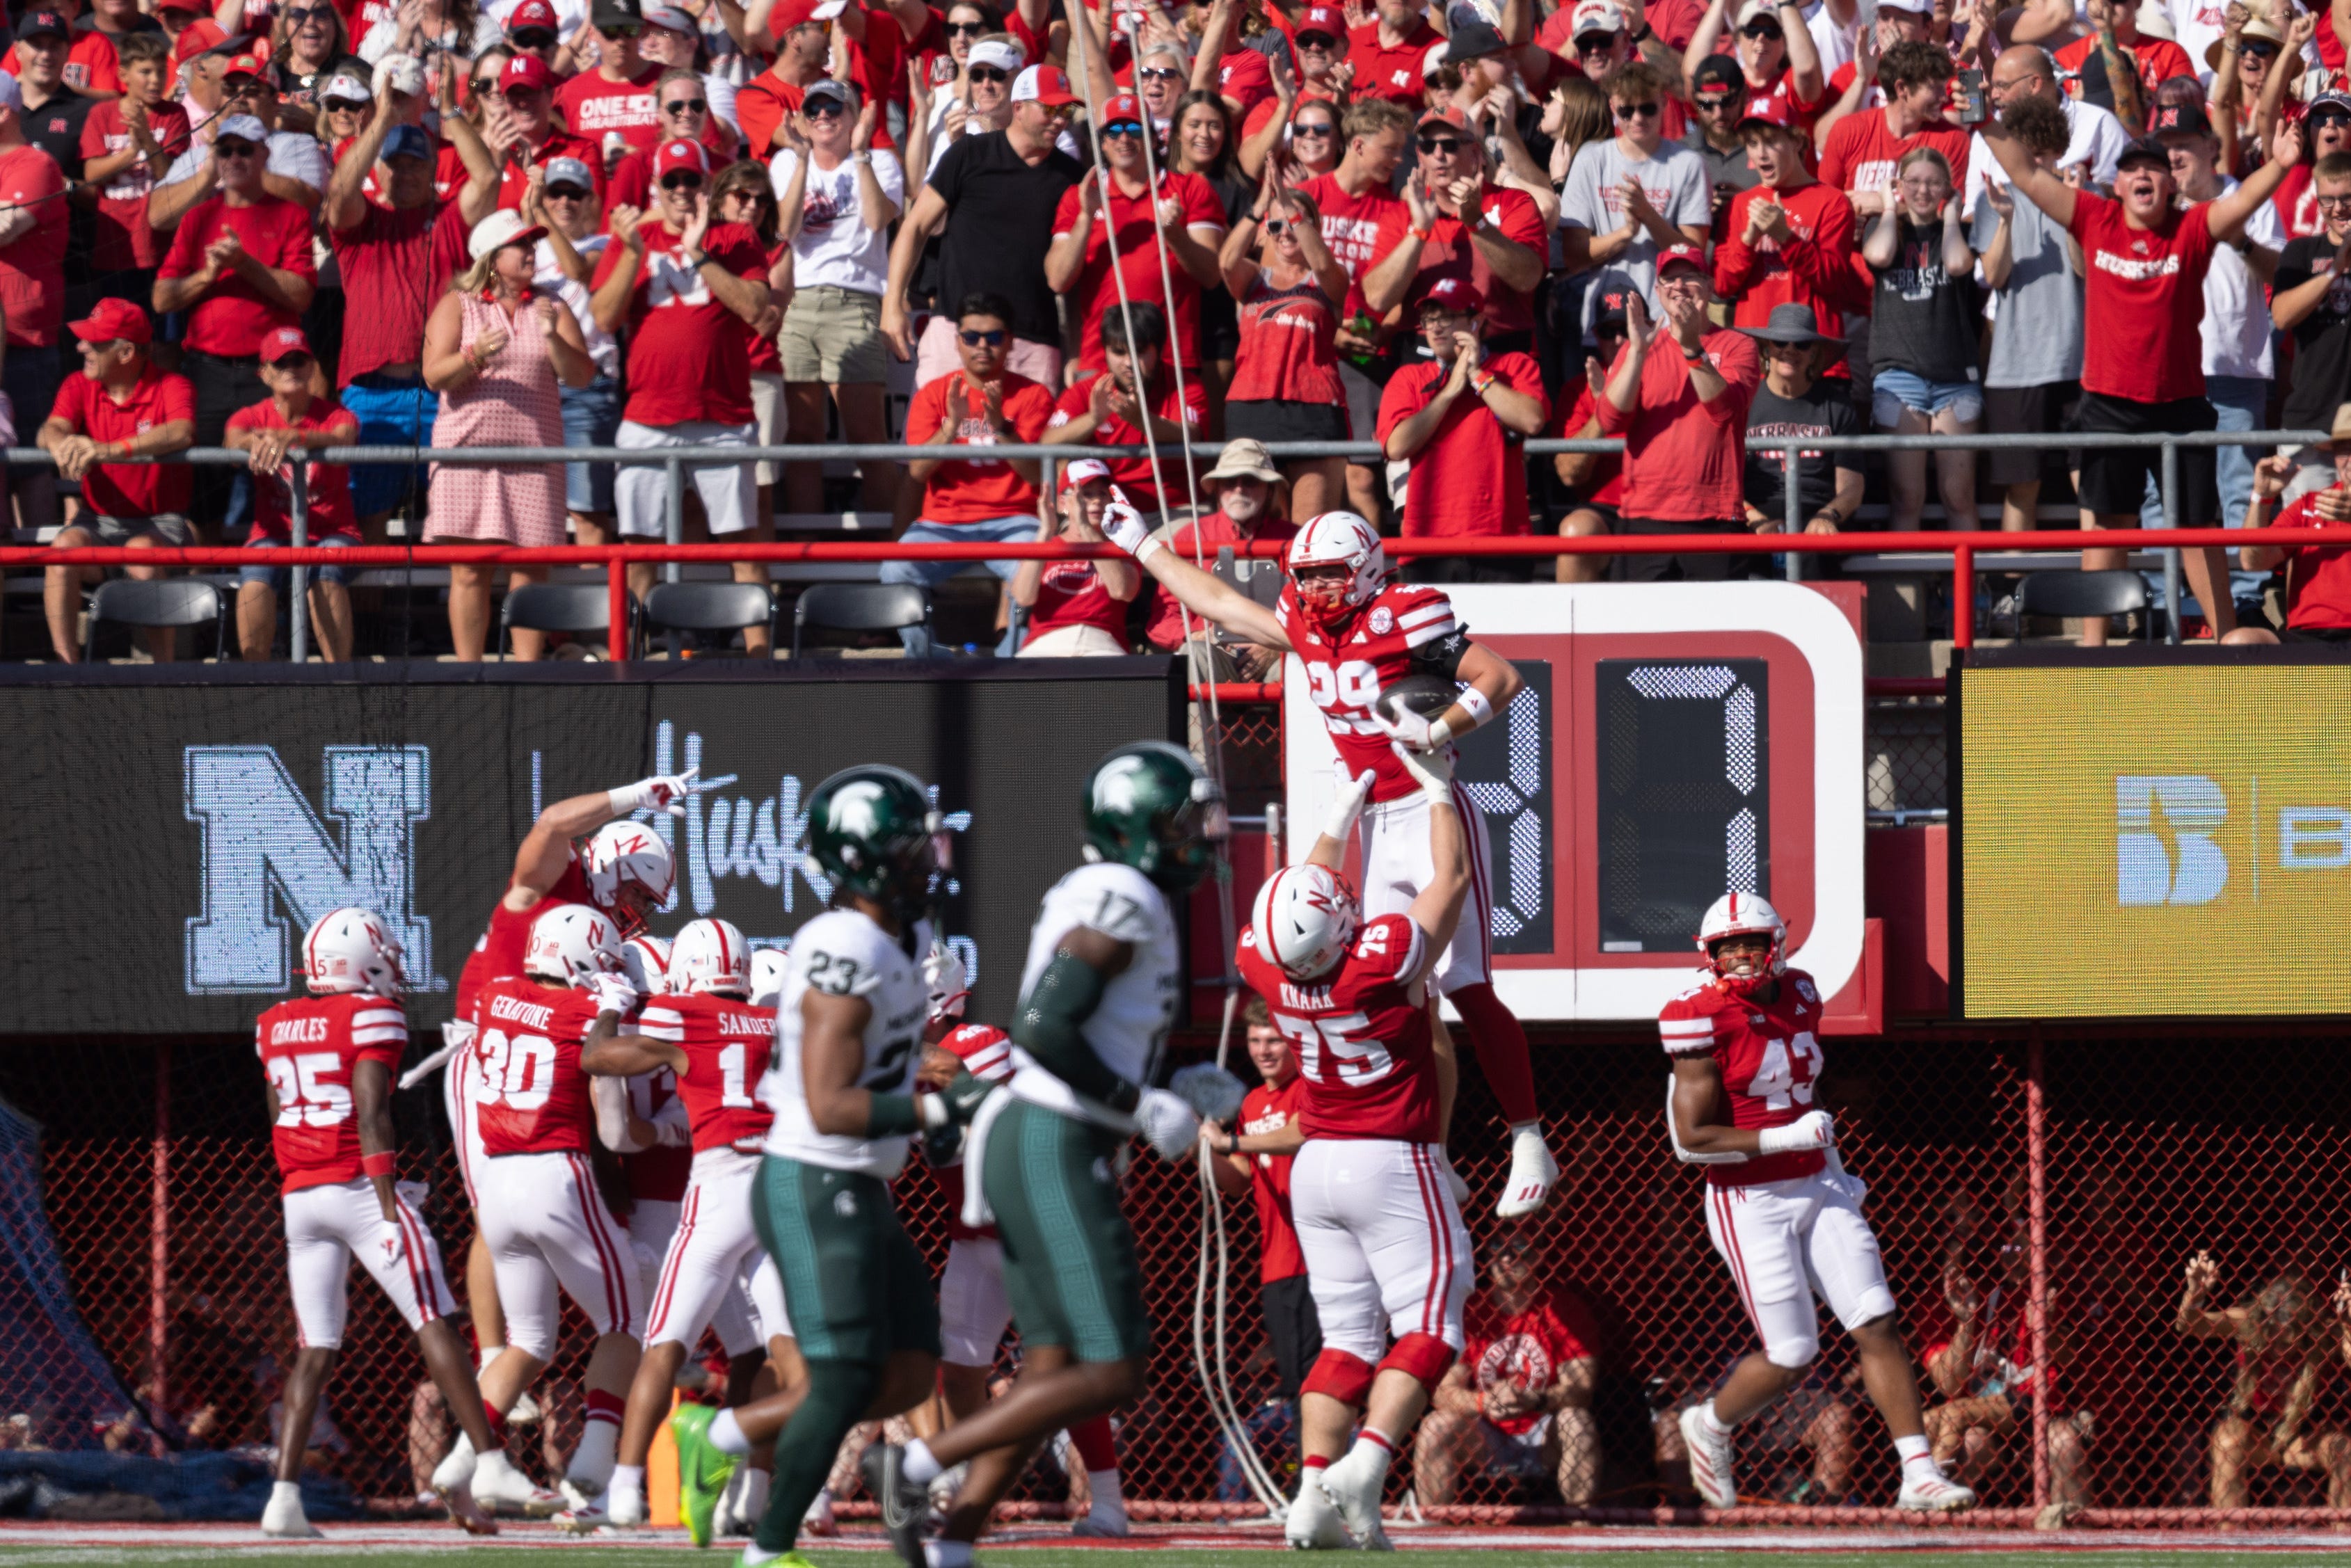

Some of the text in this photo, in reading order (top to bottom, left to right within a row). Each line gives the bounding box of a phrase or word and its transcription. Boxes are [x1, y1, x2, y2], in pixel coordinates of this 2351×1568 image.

[1311, 8, 1327, 22] N
[511, 58, 526, 74] N
[1391, 68, 1411, 88] N
[580, 96, 625, 119] ONE
[1752, 98, 1770, 114] N
[2160, 108, 2179, 128] N
[1854, 159, 1901, 192] NEBR
[648, 250, 710, 307] N
[2094, 248, 2180, 282] HUSKERS
[1604, 293, 1623, 310] N
[1351, 524, 1373, 548] N
[1307, 659, 1382, 735] 29
[184, 744, 431, 995] N
[589, 920, 605, 945] N
[1357, 924, 1390, 959] 75
[716, 954, 742, 973] 14
[808, 949, 859, 995] 23
[1279, 982, 1335, 1010] KNAAK
[491, 994, 555, 1031] GENATONE
[271, 1017, 329, 1046] CHARLES
[1273, 1010, 1393, 1088] 75
[476, 1027, 557, 1111] 30
[1747, 1031, 1825, 1112] 43
[267, 1051, 352, 1127] 25
